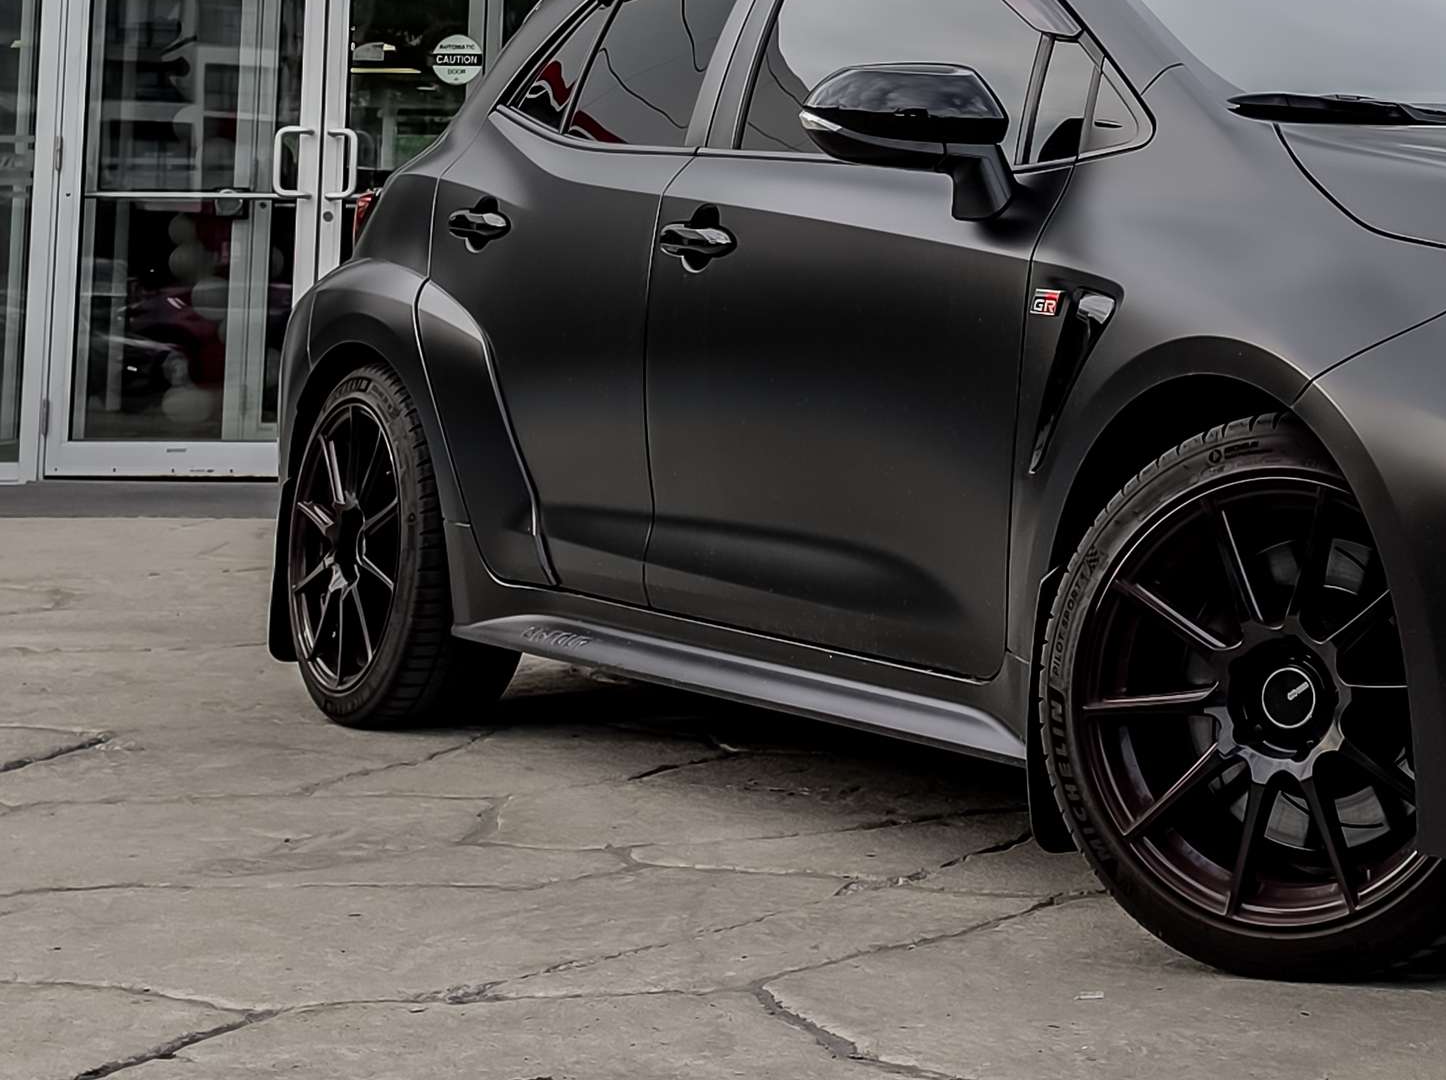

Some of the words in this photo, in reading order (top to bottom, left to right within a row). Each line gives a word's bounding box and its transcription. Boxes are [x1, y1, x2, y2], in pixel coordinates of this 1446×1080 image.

[435, 54, 478, 65] CAUTION
[1032, 296, 1057, 314] GR
[1052, 632, 1066, 676] PILOT
[1061, 581, 1083, 631] SPORT
[1049, 699, 1111, 863] MICHELIN
